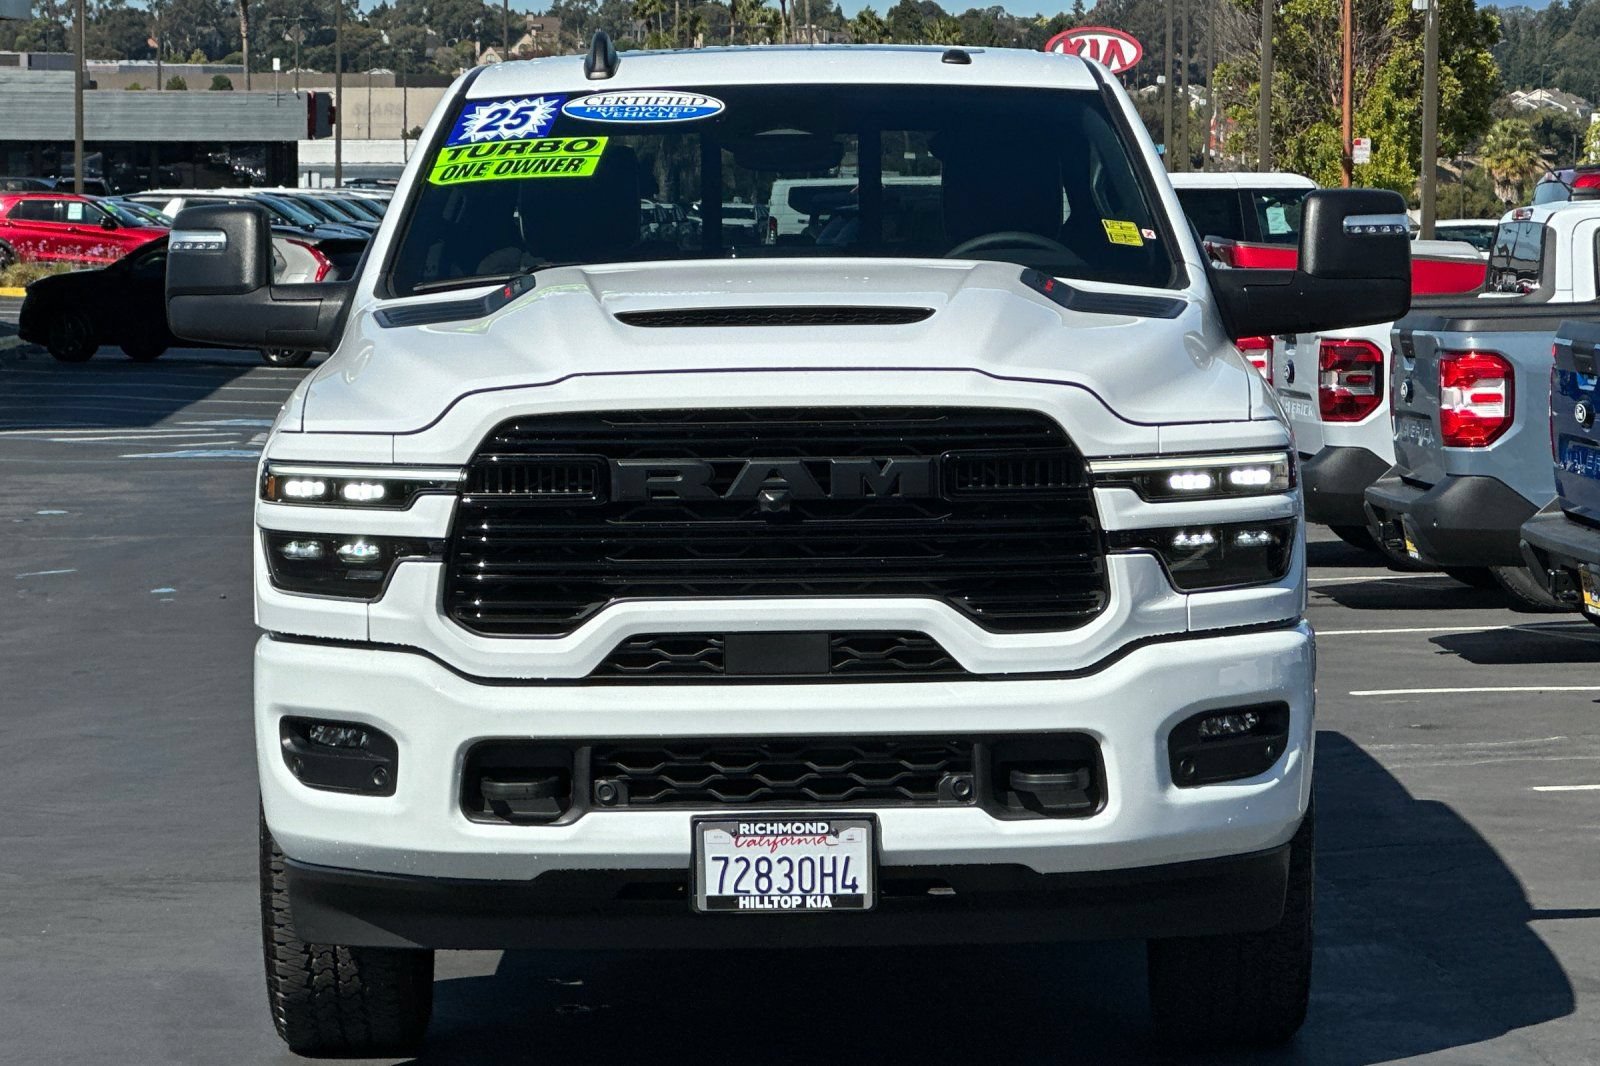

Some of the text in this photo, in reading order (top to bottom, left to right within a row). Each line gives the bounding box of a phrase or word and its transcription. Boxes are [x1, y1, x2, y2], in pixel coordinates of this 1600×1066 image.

[1063, 38, 1128, 68] KIA
[583, 96, 708, 106] CERTIFIED
[475, 105, 538, 133] 25
[447, 138, 600, 161] TURBO
[438, 157, 587, 182] ONE OWNER
[611, 456, 937, 502] RAM
[738, 822, 829, 835] RICHMOND
[734, 835, 839, 854] California
[711, 855, 859, 894] 72830H4
[738, 895, 833, 909] HILLTOP KIA
